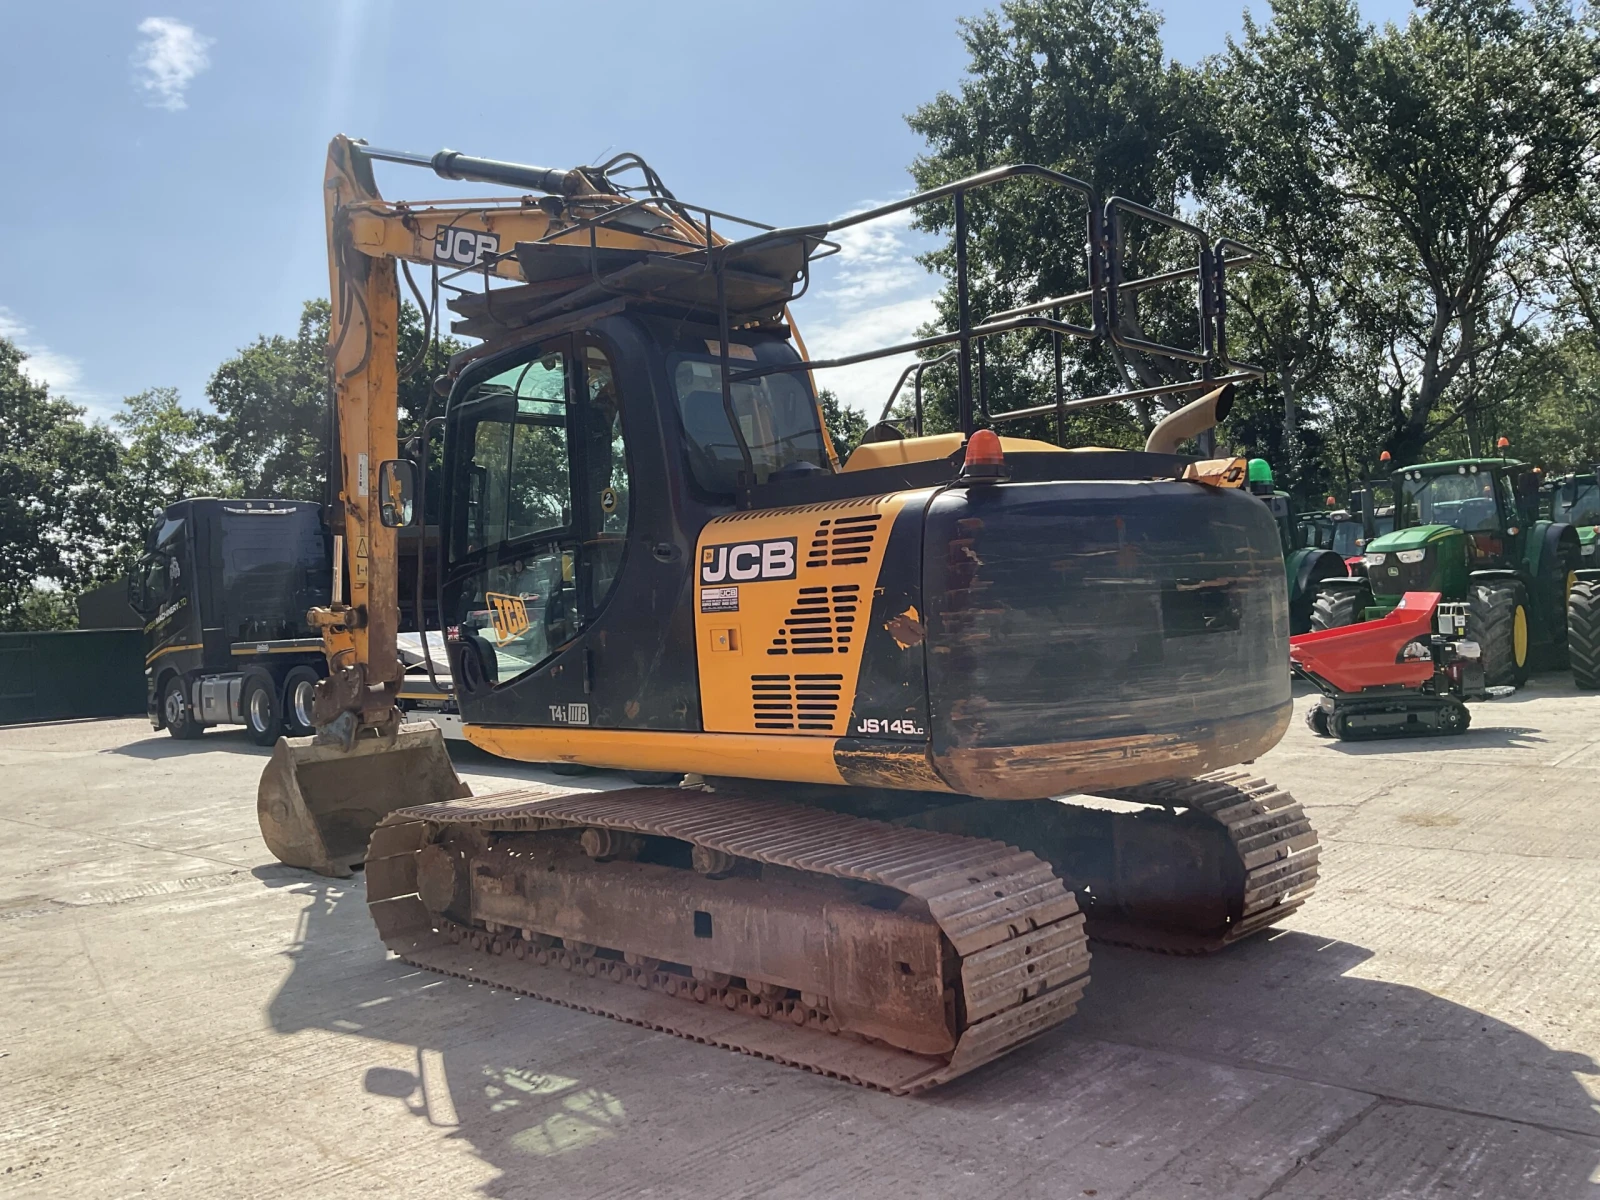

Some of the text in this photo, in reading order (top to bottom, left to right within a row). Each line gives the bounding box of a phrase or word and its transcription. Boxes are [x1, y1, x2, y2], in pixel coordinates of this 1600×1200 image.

[435, 229, 498, 267] JCB
[702, 540, 795, 582] JCB
[720, 589, 736, 597] JCB
[493, 597, 526, 640] JCB
[548, 705, 568, 722] T4i
